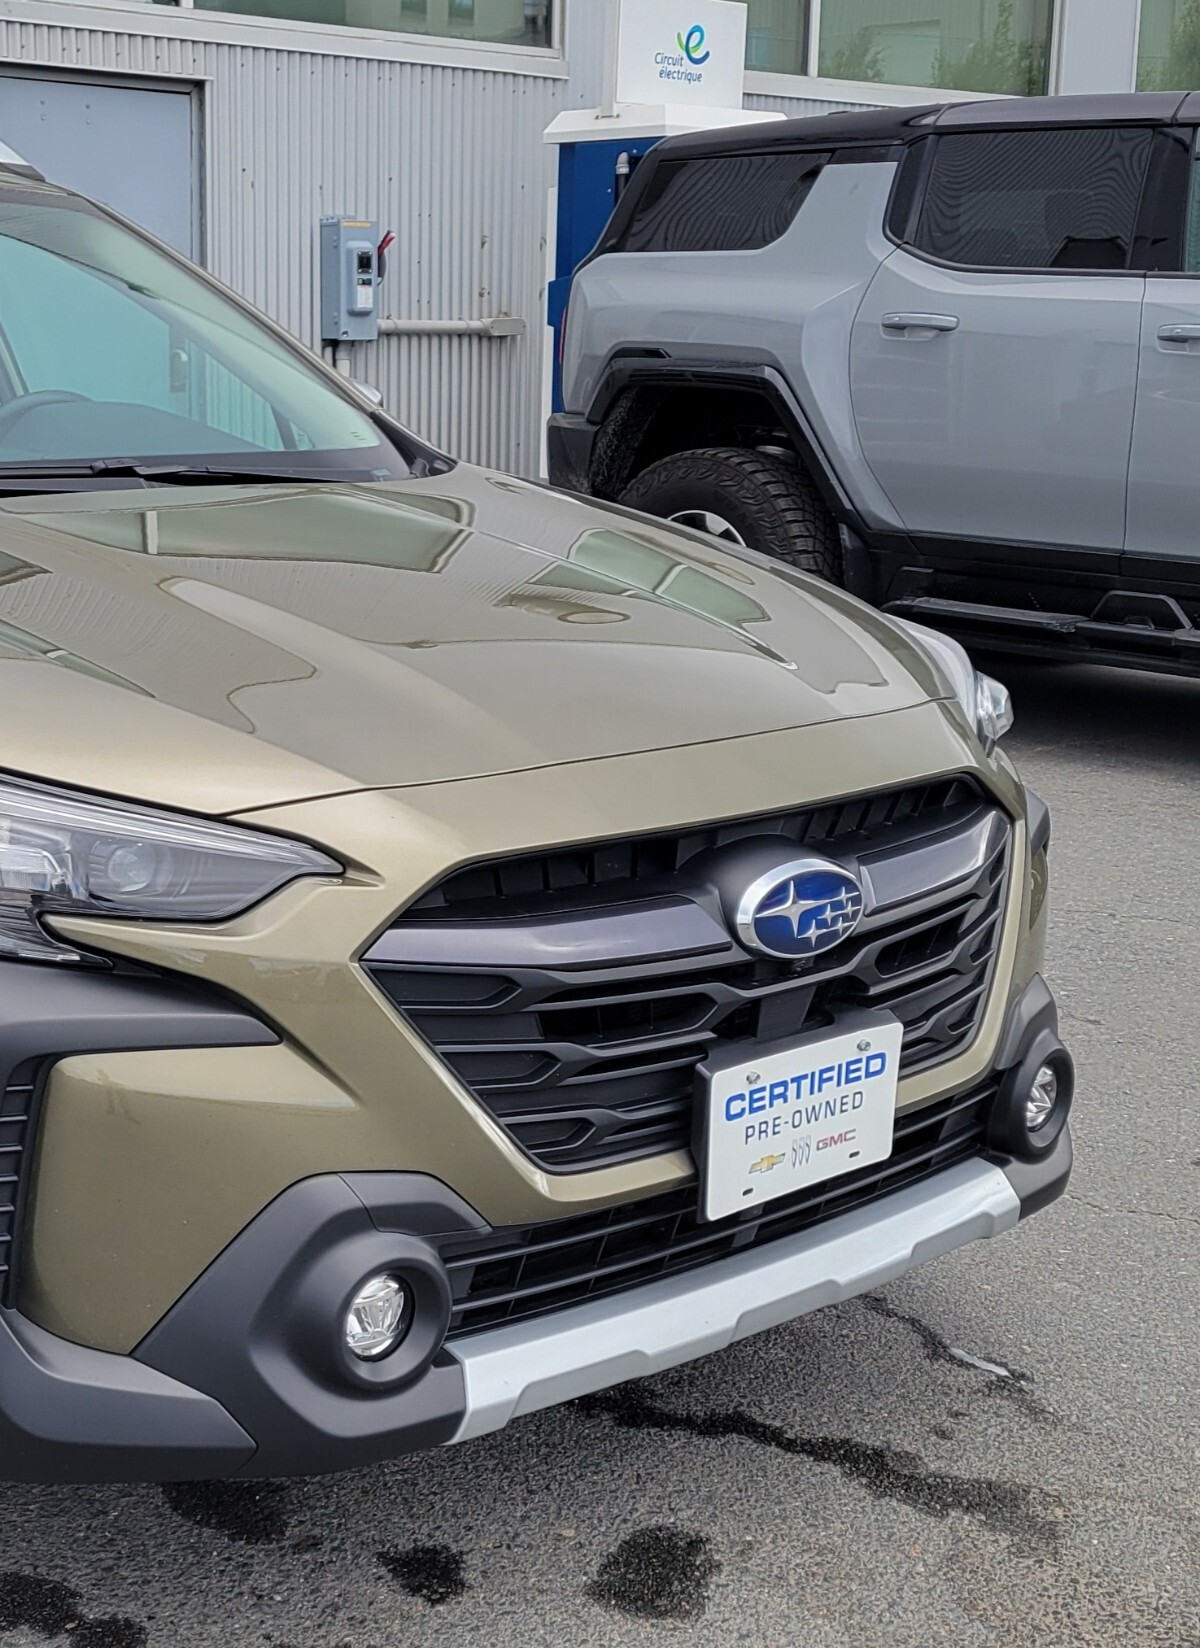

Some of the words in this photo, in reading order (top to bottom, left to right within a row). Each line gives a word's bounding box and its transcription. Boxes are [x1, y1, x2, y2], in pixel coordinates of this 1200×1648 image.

[654, 52, 684, 67] Circuit
[658, 66, 703, 84] électrique
[725, 1052, 887, 1122] CERTIFIED
[744, 1090, 864, 1146] PRE-OWNED
[816, 1128, 857, 1151] GMC
